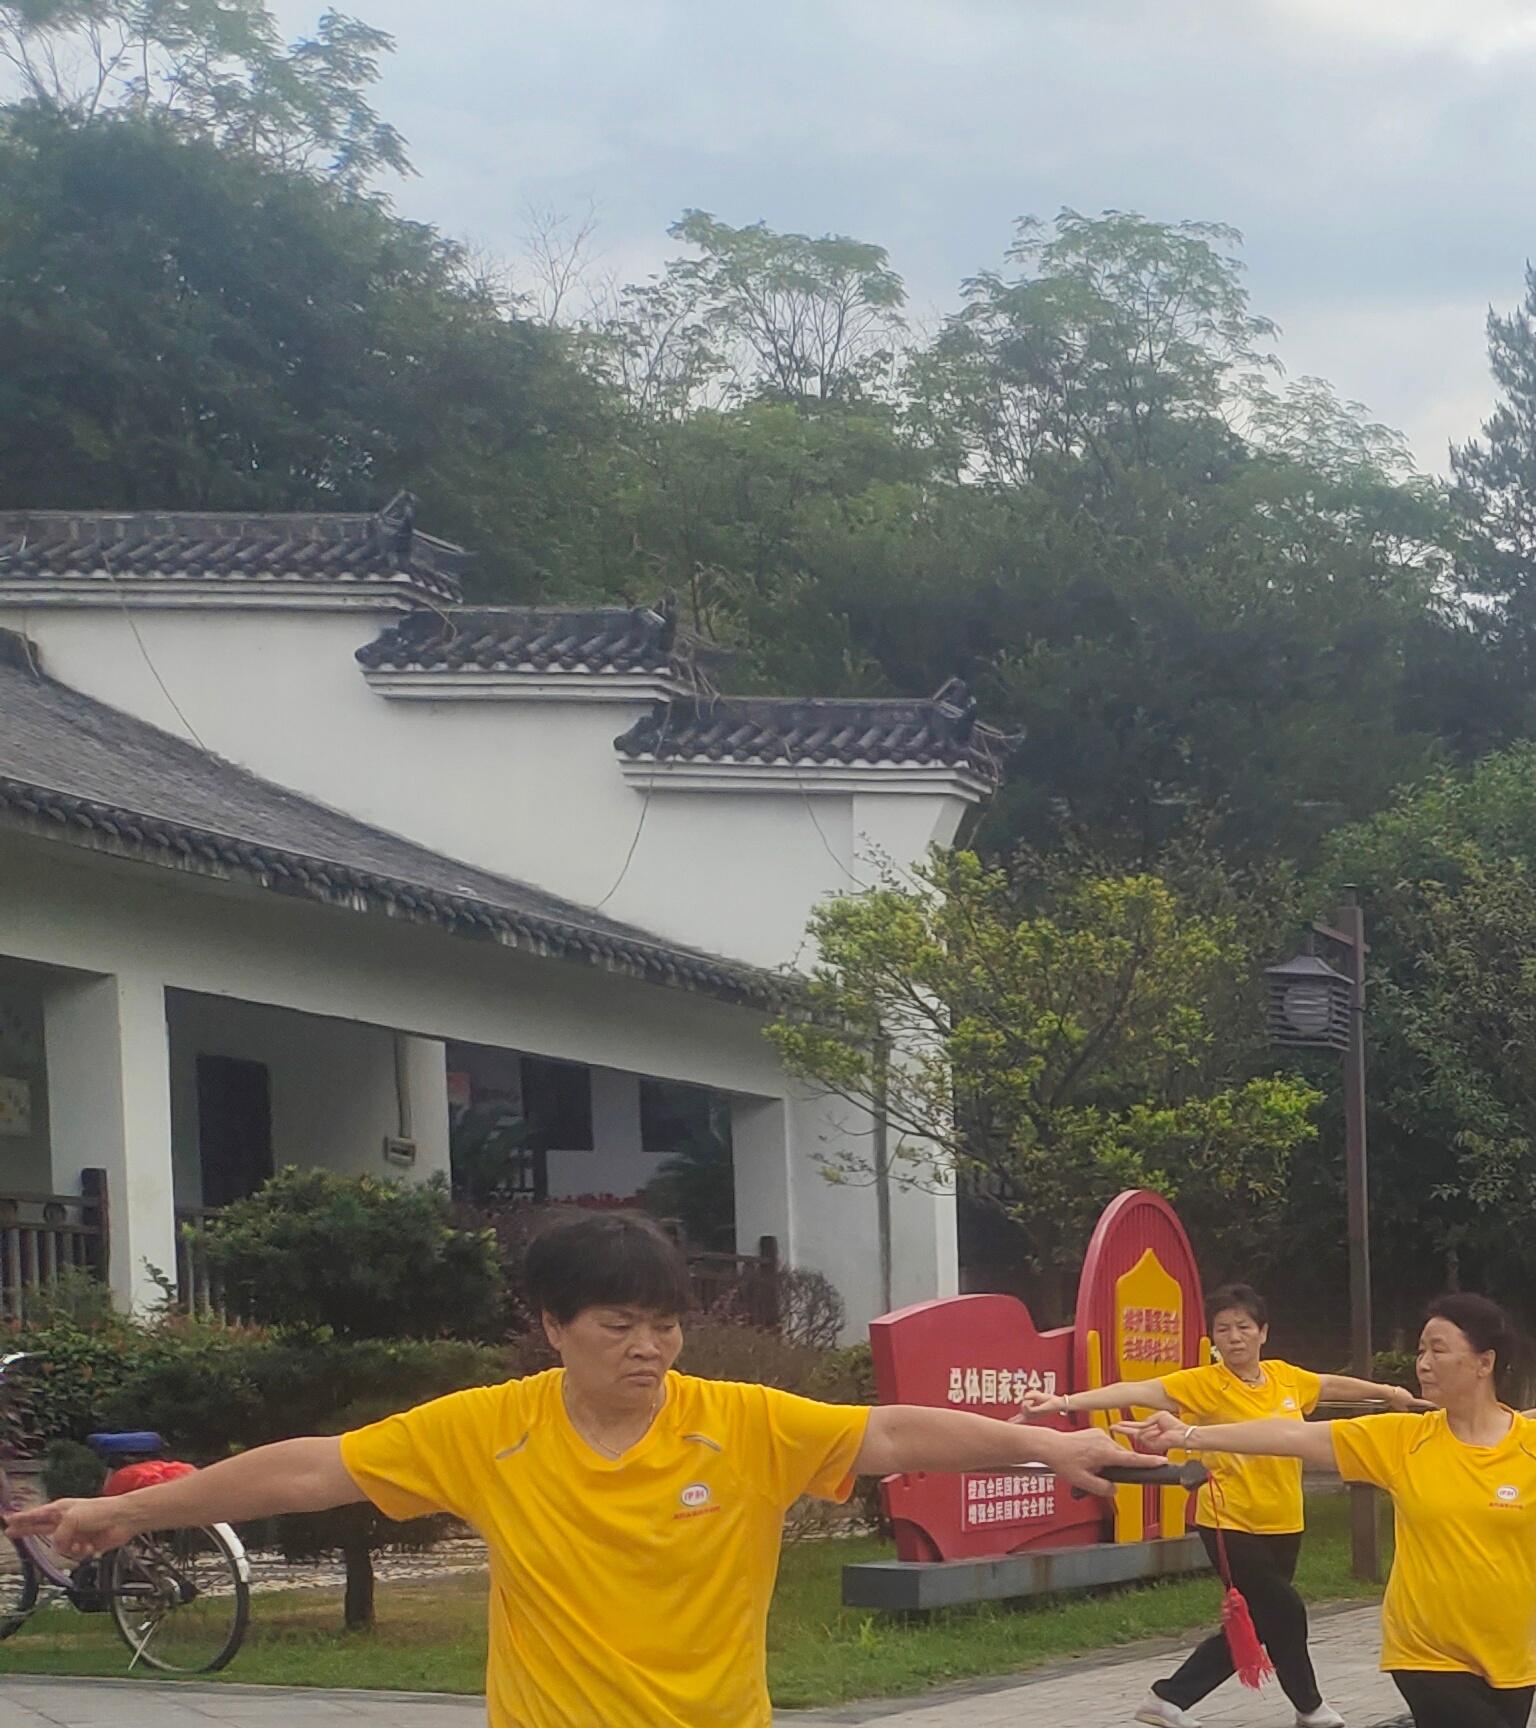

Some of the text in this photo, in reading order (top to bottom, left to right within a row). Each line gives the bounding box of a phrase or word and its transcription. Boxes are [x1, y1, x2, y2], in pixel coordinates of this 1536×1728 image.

[948, 1367, 1056, 1405] 总体国家安全观
[968, 1496, 1056, 1525] 增强全民国家安全责任
